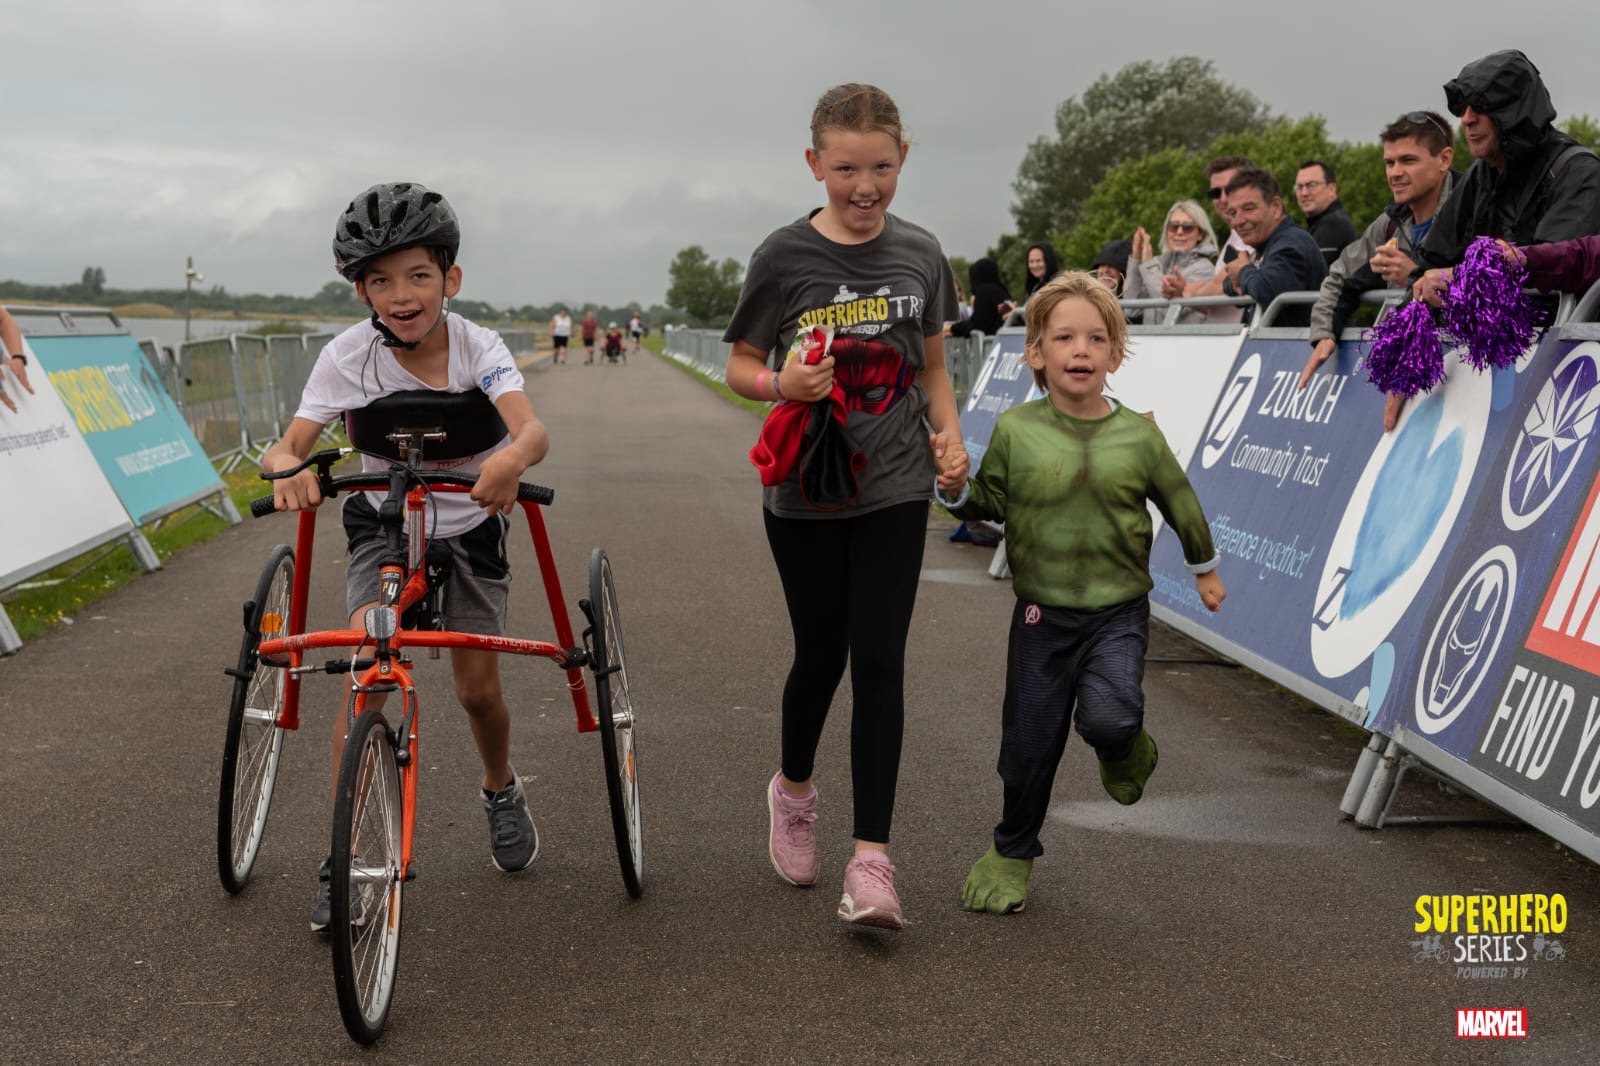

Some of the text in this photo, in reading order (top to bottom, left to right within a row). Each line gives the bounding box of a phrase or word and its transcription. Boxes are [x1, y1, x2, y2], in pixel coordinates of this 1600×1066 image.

[798, 297, 889, 330] SUPERHERO
[1257, 370, 1348, 424] ZURICH
[1230, 434, 1330, 489] Community Trust
[1479, 664, 1576, 781] FIND
